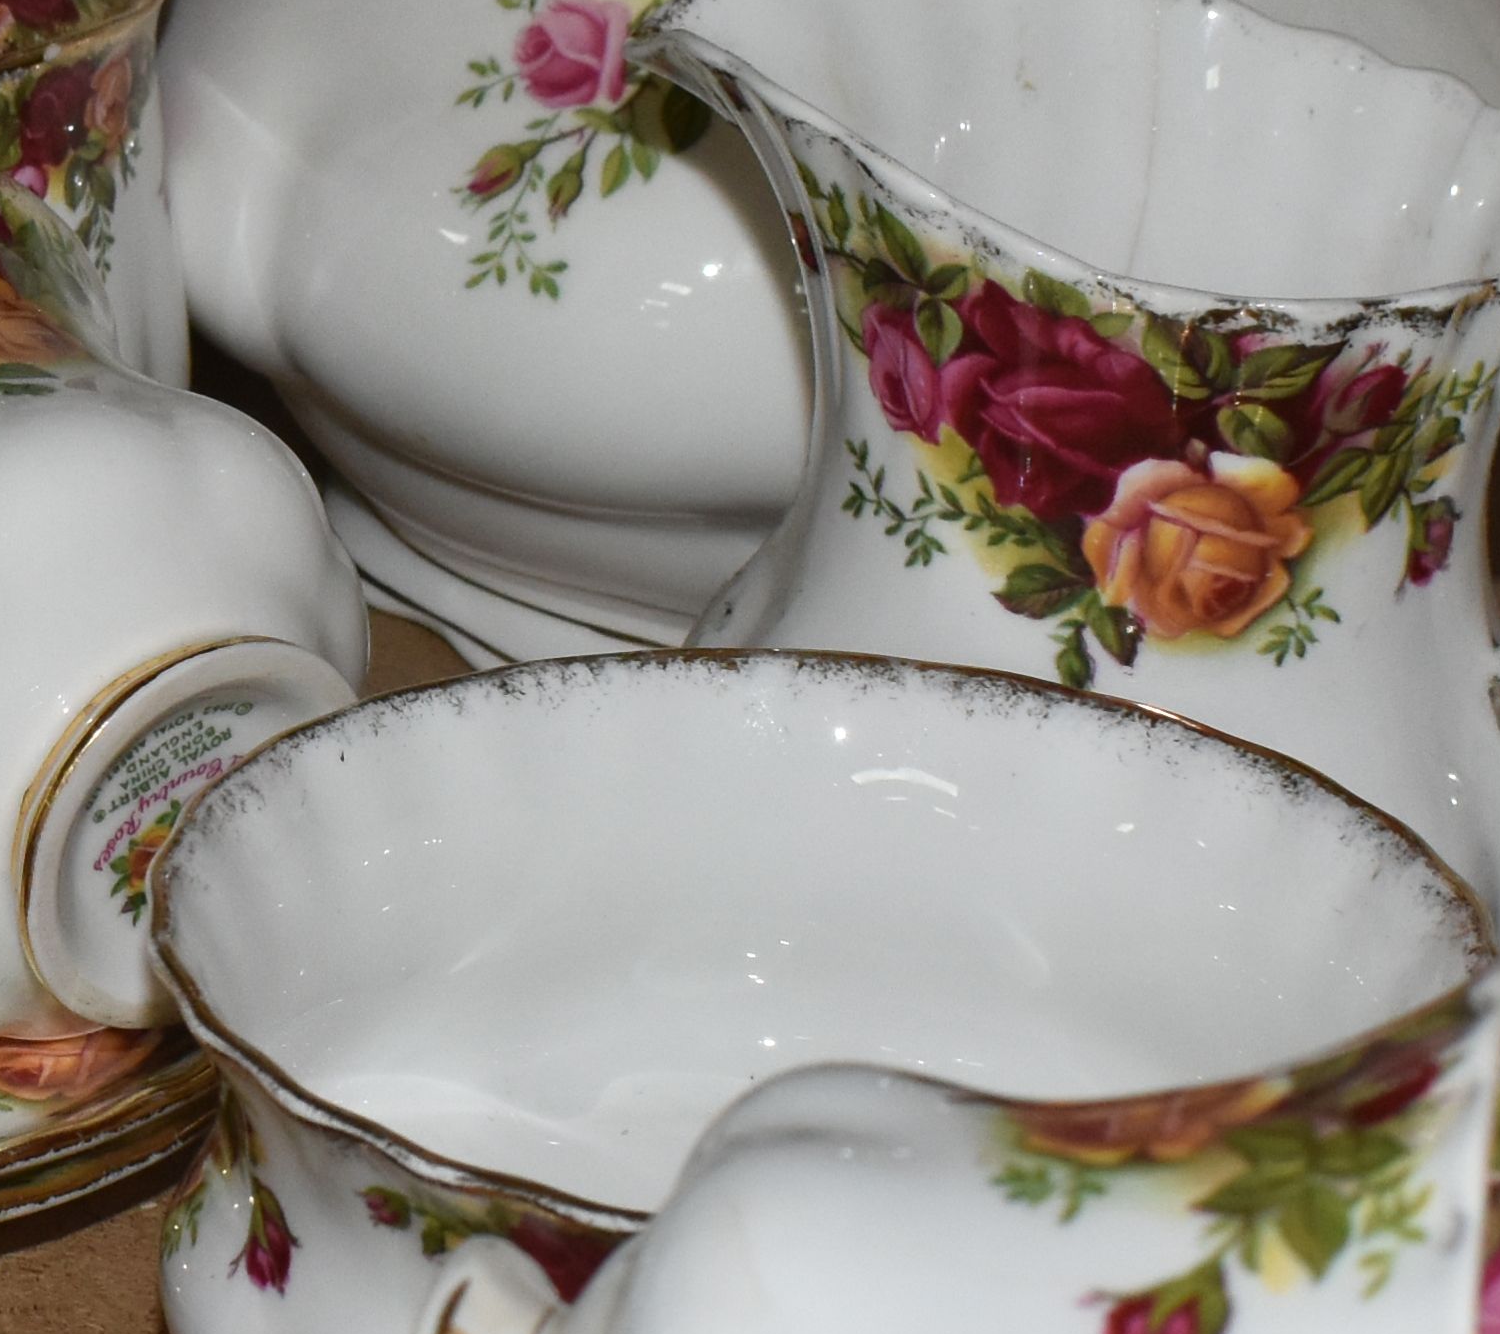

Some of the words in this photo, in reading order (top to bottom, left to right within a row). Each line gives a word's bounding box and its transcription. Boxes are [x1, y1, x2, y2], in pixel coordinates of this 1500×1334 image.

[126, 719, 204, 774] ENGLAND
[170, 725, 216, 760] BONE
[179, 727, 233, 766] ROYAL
[119, 758, 166, 790] CHINA
[138, 757, 224, 813] Country
[93, 810, 142, 872] Roses
